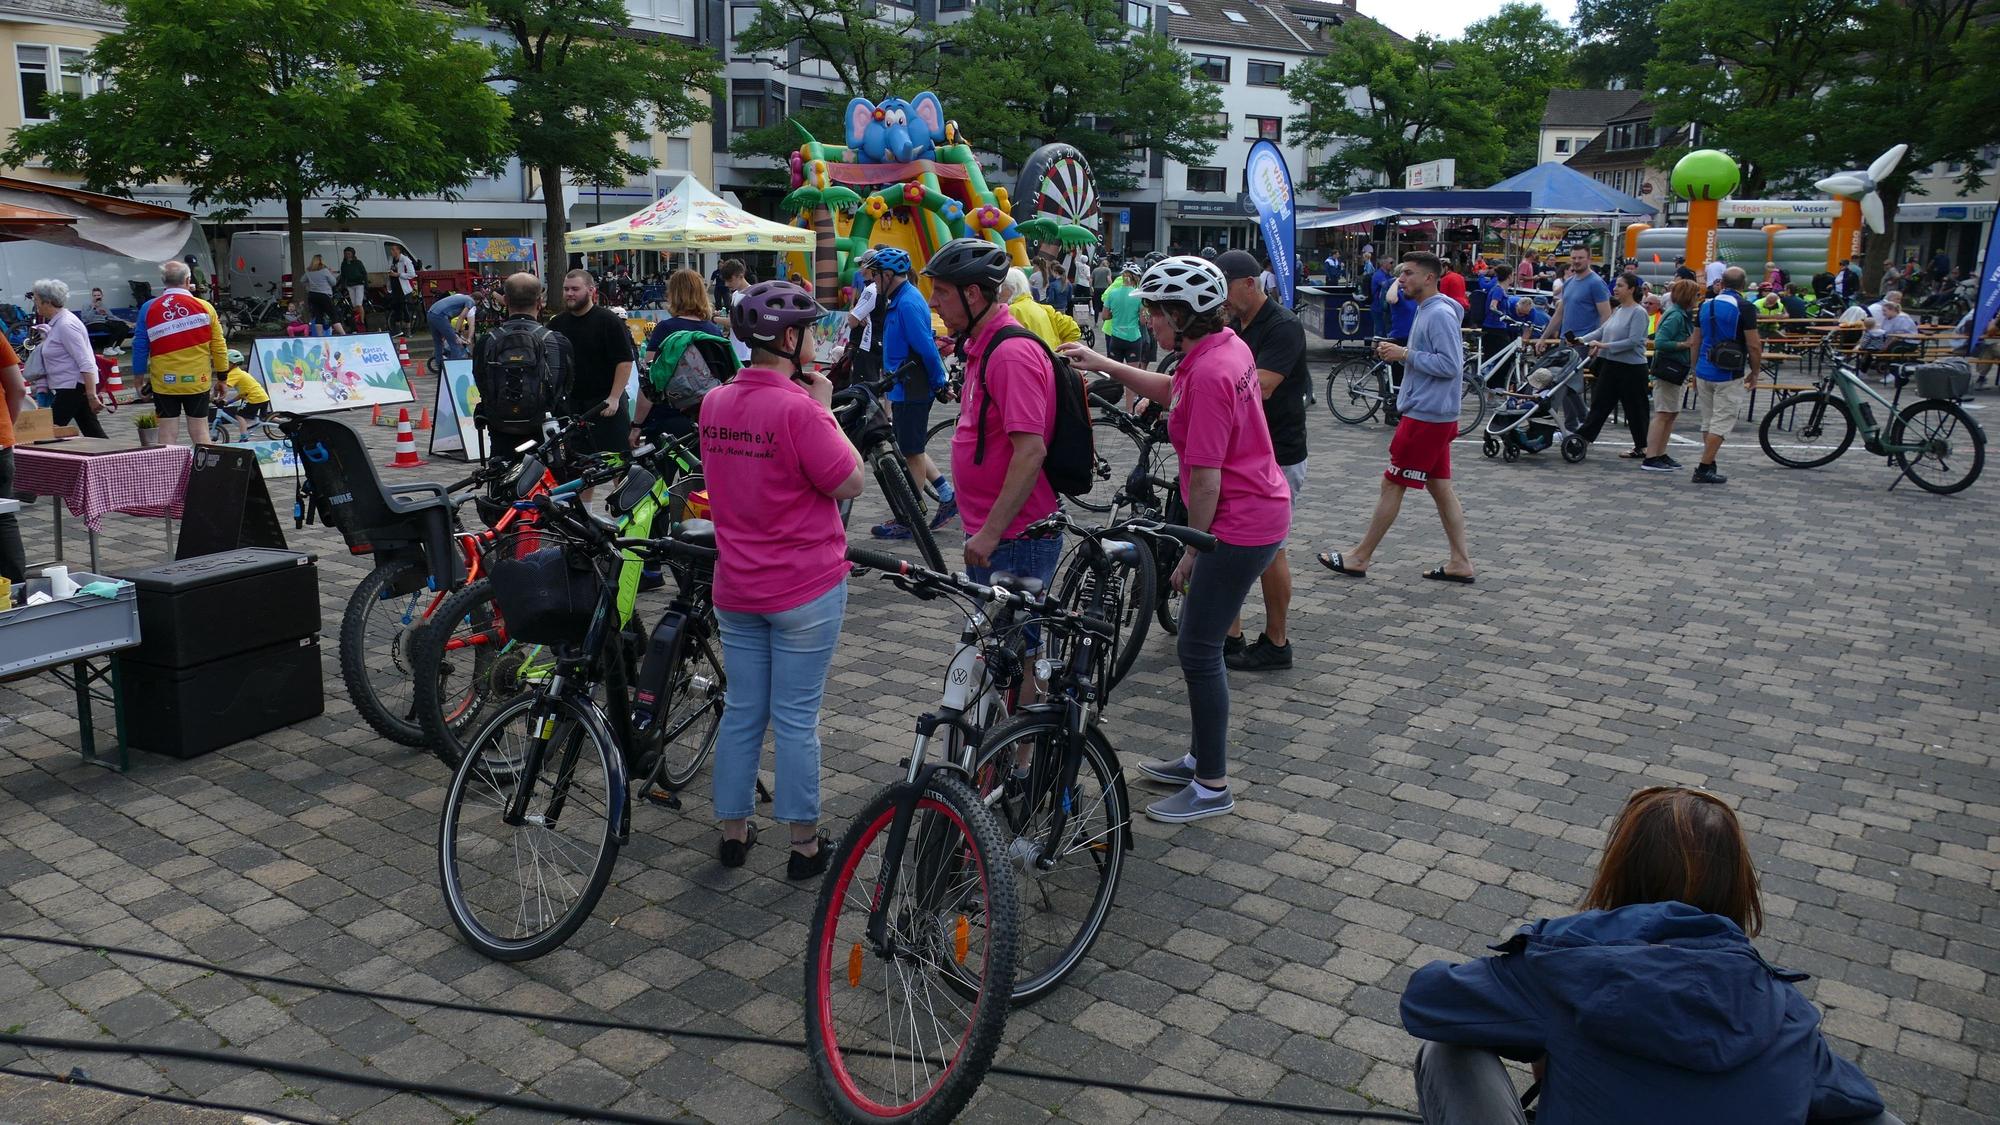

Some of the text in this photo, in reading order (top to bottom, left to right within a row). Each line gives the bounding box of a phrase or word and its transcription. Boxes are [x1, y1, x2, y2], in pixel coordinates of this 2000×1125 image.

[1066, 148, 1074, 158] 20
[1732, 204, 1760, 213] Erdgas
[1792, 204, 1829, 213] Wasser
[1702, 229, 1716, 265] henag
[361, 352, 389, 364] Welt
[703, 426, 718, 439] KG
[719, 427, 753, 443] Bierth
[1402, 469, 1428, 482] CHILL
